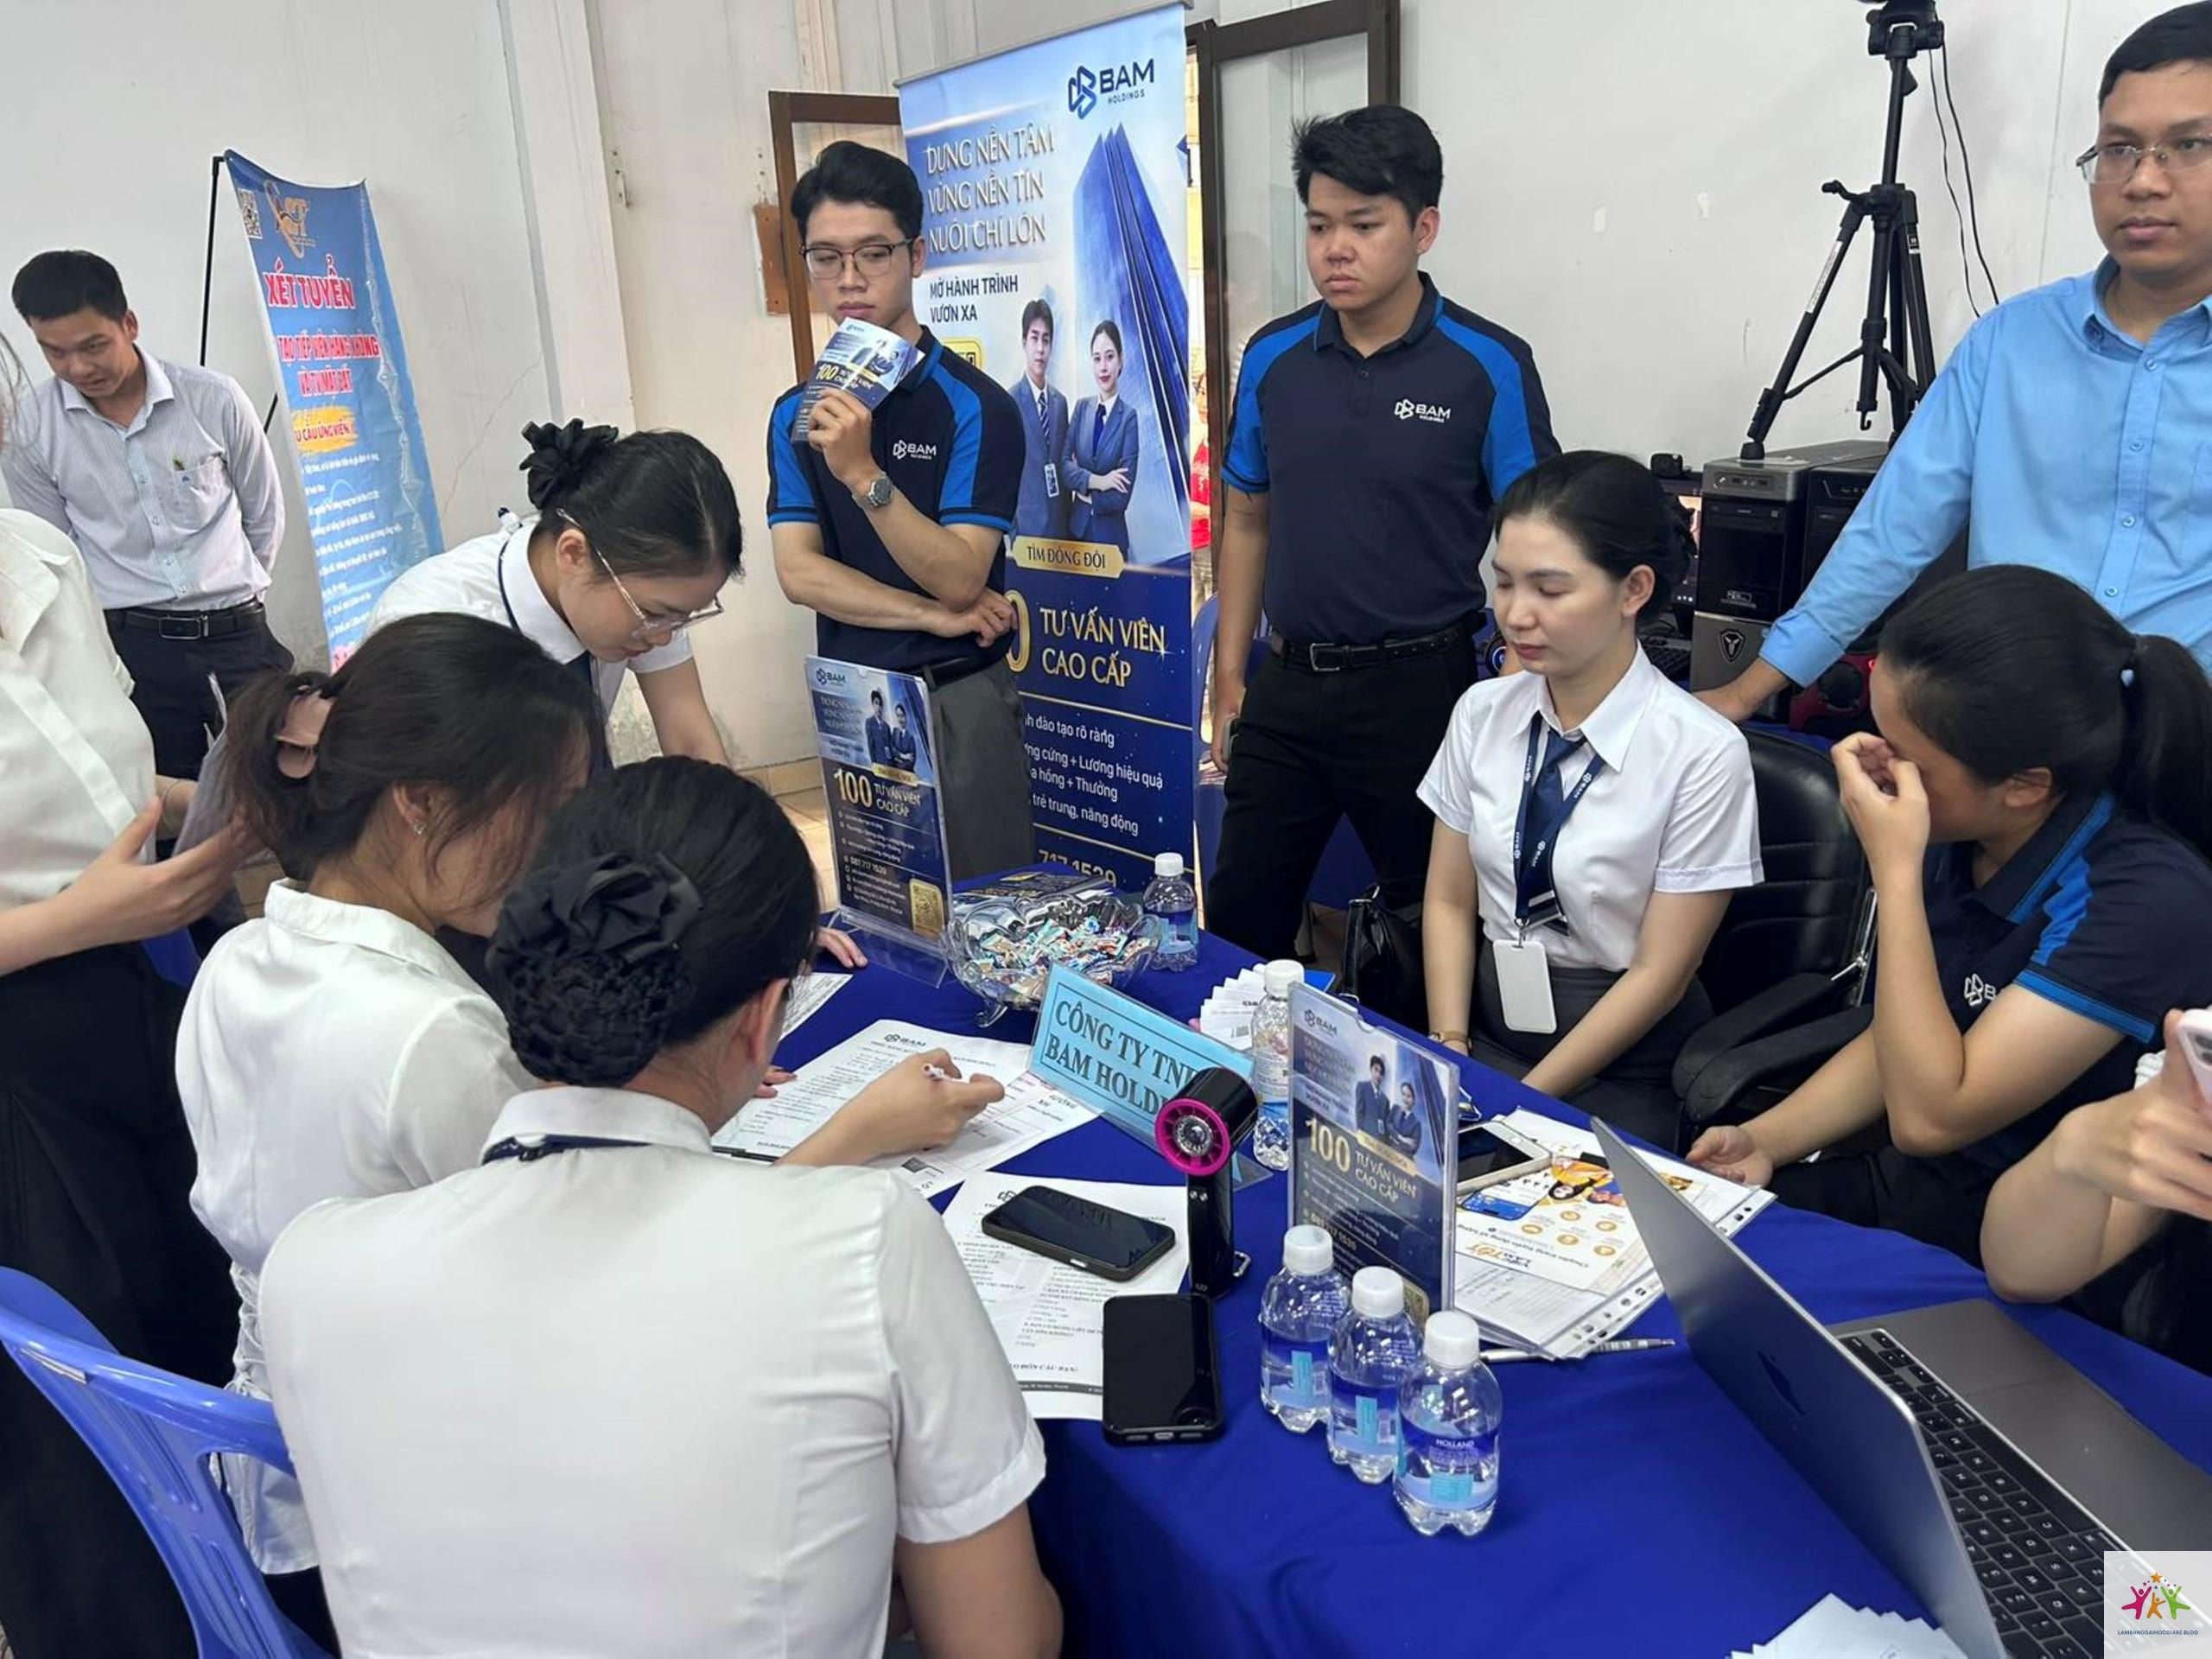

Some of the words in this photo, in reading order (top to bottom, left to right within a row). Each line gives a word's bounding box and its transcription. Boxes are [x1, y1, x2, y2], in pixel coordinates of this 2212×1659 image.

[1100, 58, 1154, 94] BAM
[1108, 89, 1145, 104] HOLDINGS
[945, 276, 980, 297] HÀNH
[982, 272, 1019, 295] TRÌNH
[930, 304, 959, 323] VƯƠN
[961, 304, 978, 321] XA
[1416, 404, 1452, 419] BAM
[907, 442, 937, 456] BAM
[1027, 543, 1045, 561] TÌM
[1084, 550, 1106, 572] ĐỘI
[1039, 607, 1068, 637] TƯ
[1069, 607, 1115, 645] VẤN
[1117, 616, 1166, 654] VIÊN
[1042, 648, 1086, 679] CAO
[1091, 651, 1132, 687] CẤP
[1036, 716, 1055, 732] đào
[1057, 722, 1074, 738] tạo
[1076, 725, 1088, 740] rõ
[1042, 747, 1069, 768] cứng
[1079, 755, 1115, 779] Lương
[1116, 763, 1141, 784] hiệu
[833, 768, 873, 808] 100
[1033, 793, 1047, 808] trẻ
[1081, 807, 1109, 829] năng
[1110, 814, 1139, 836] động
[1055, 1001, 1115, 1052] CÔNG
[1117, 1032, 1150, 1069] TY
[1045, 1034, 1093, 1081] BAM
[1306, 1117, 1351, 1173] 100
